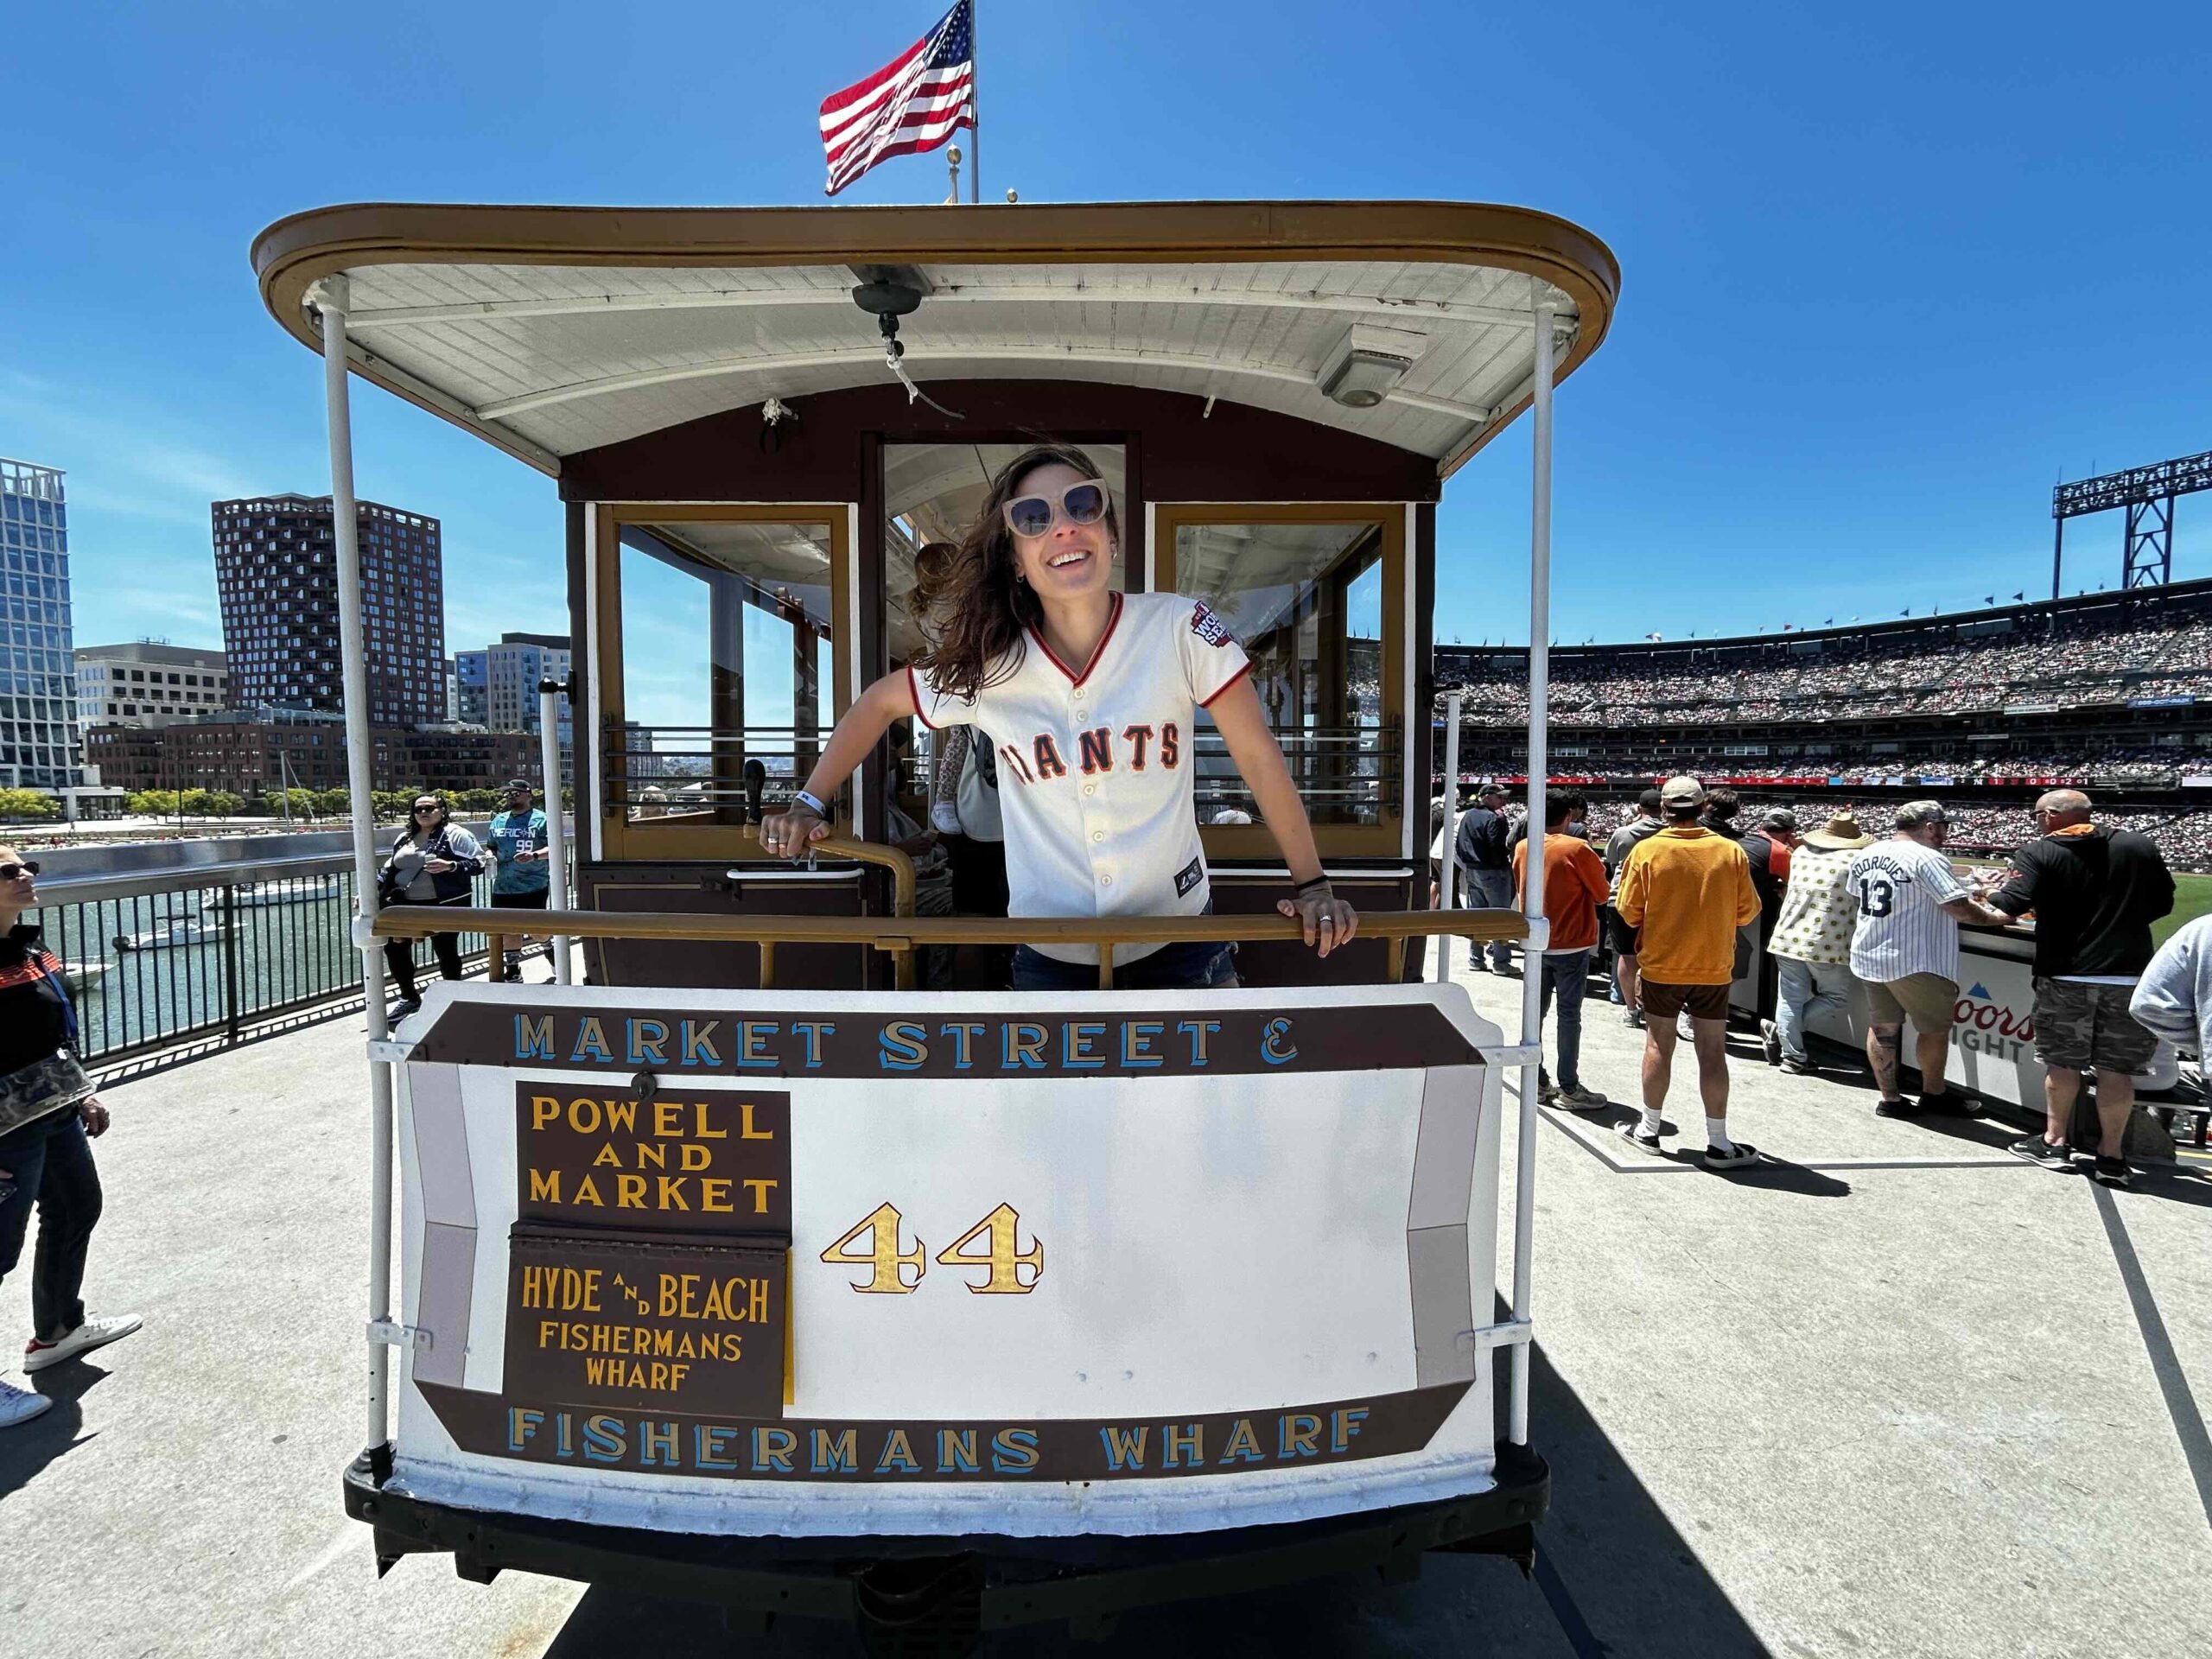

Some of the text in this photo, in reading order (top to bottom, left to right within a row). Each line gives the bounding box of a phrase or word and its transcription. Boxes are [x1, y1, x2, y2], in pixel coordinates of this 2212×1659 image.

[516, 840, 533, 852] 99
[1852, 855, 1912, 887] RODRIGUEZ
[1859, 878, 1893, 918] 13
[1953, 999, 2035, 1041] oors
[514, 1013, 836, 1068] MARKET
[878, 1020, 1221, 1070] STREET
[1950, 1025, 2024, 1064] IGHT
[531, 1096, 773, 1141] POWELL
[592, 1142, 712, 1171] AND
[529, 1167, 778, 1214] MARKET
[820, 1201, 1044, 1294] 44
[521, 1265, 601, 1313] HYDE
[658, 1273, 769, 1324] BEACH
[538, 1320, 742, 1363] FISHERMANS
[586, 1357, 690, 1392] WHARF
[507, 1406, 1369, 1474] FISHERMANS WHARF
